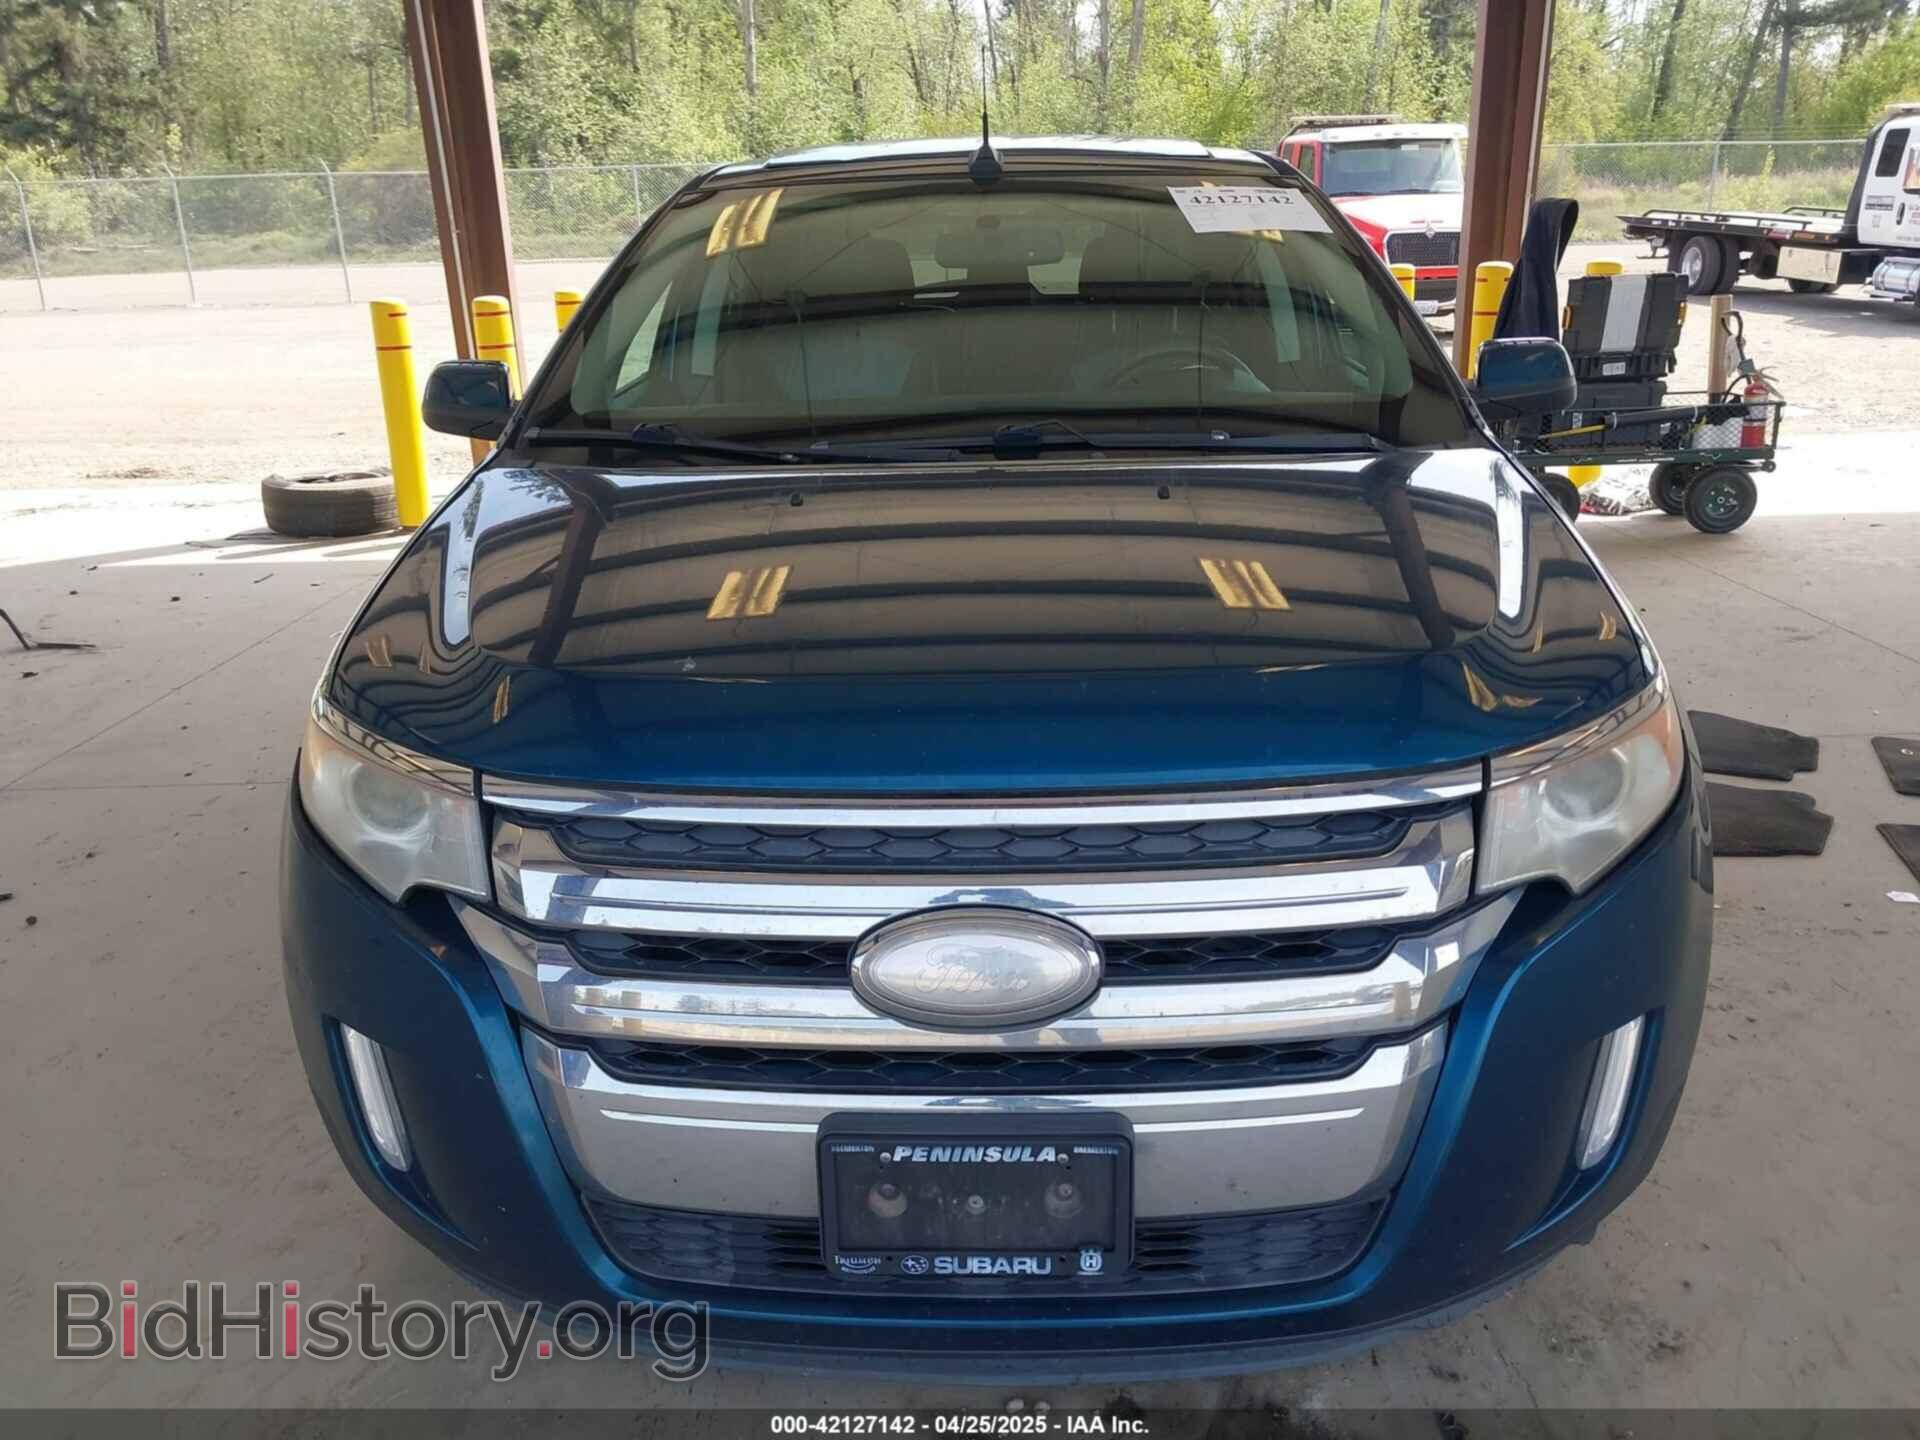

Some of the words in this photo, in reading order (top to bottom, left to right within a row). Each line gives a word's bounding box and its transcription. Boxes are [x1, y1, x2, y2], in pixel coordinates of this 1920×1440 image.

[1189, 194, 1295, 205] 42127142
[893, 1145, 1056, 1163] PENINSULA
[934, 1256, 1051, 1275] SUBARU
